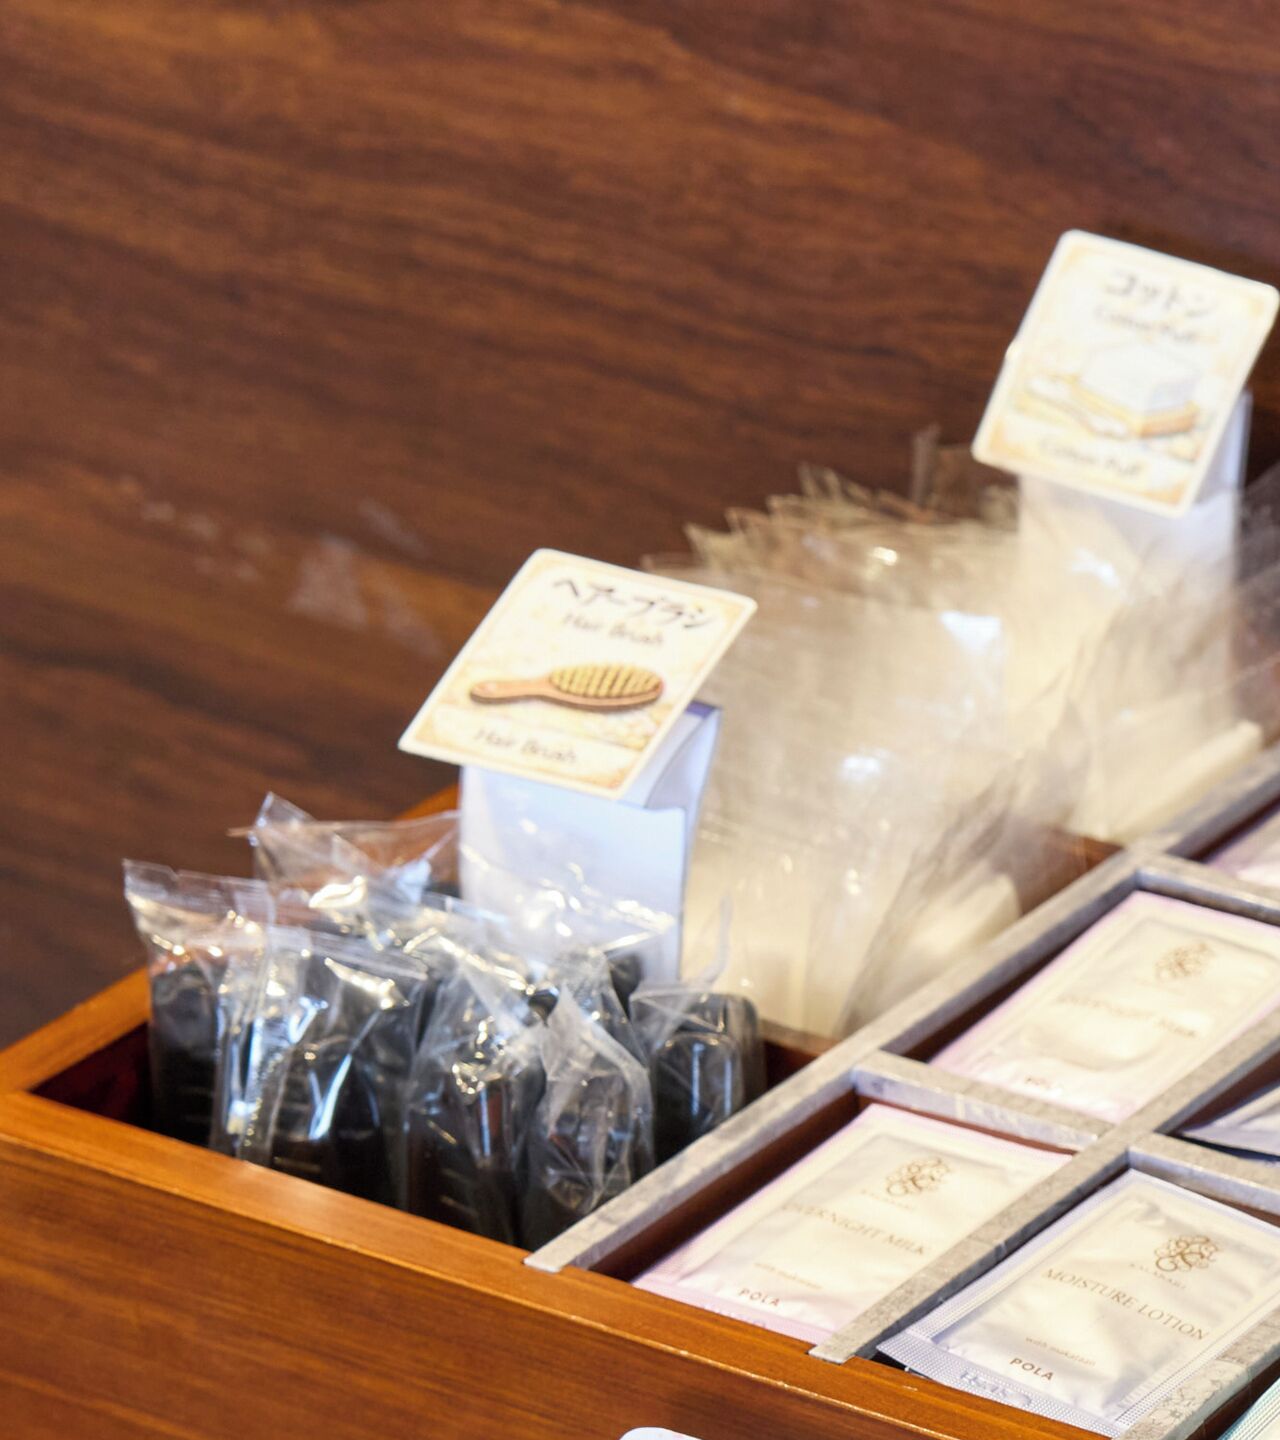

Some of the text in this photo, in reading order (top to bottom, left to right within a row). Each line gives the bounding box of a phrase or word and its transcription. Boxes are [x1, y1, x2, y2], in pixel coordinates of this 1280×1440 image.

[1104, 270, 1218, 318] コットン
[553, 576, 713, 630] ヘアーブラシ
[737, 1286, 780, 1308] POLA
[1041, 1265, 1210, 1342] MOISTURE LOTION
[1009, 1356, 1055, 1382] POLA
